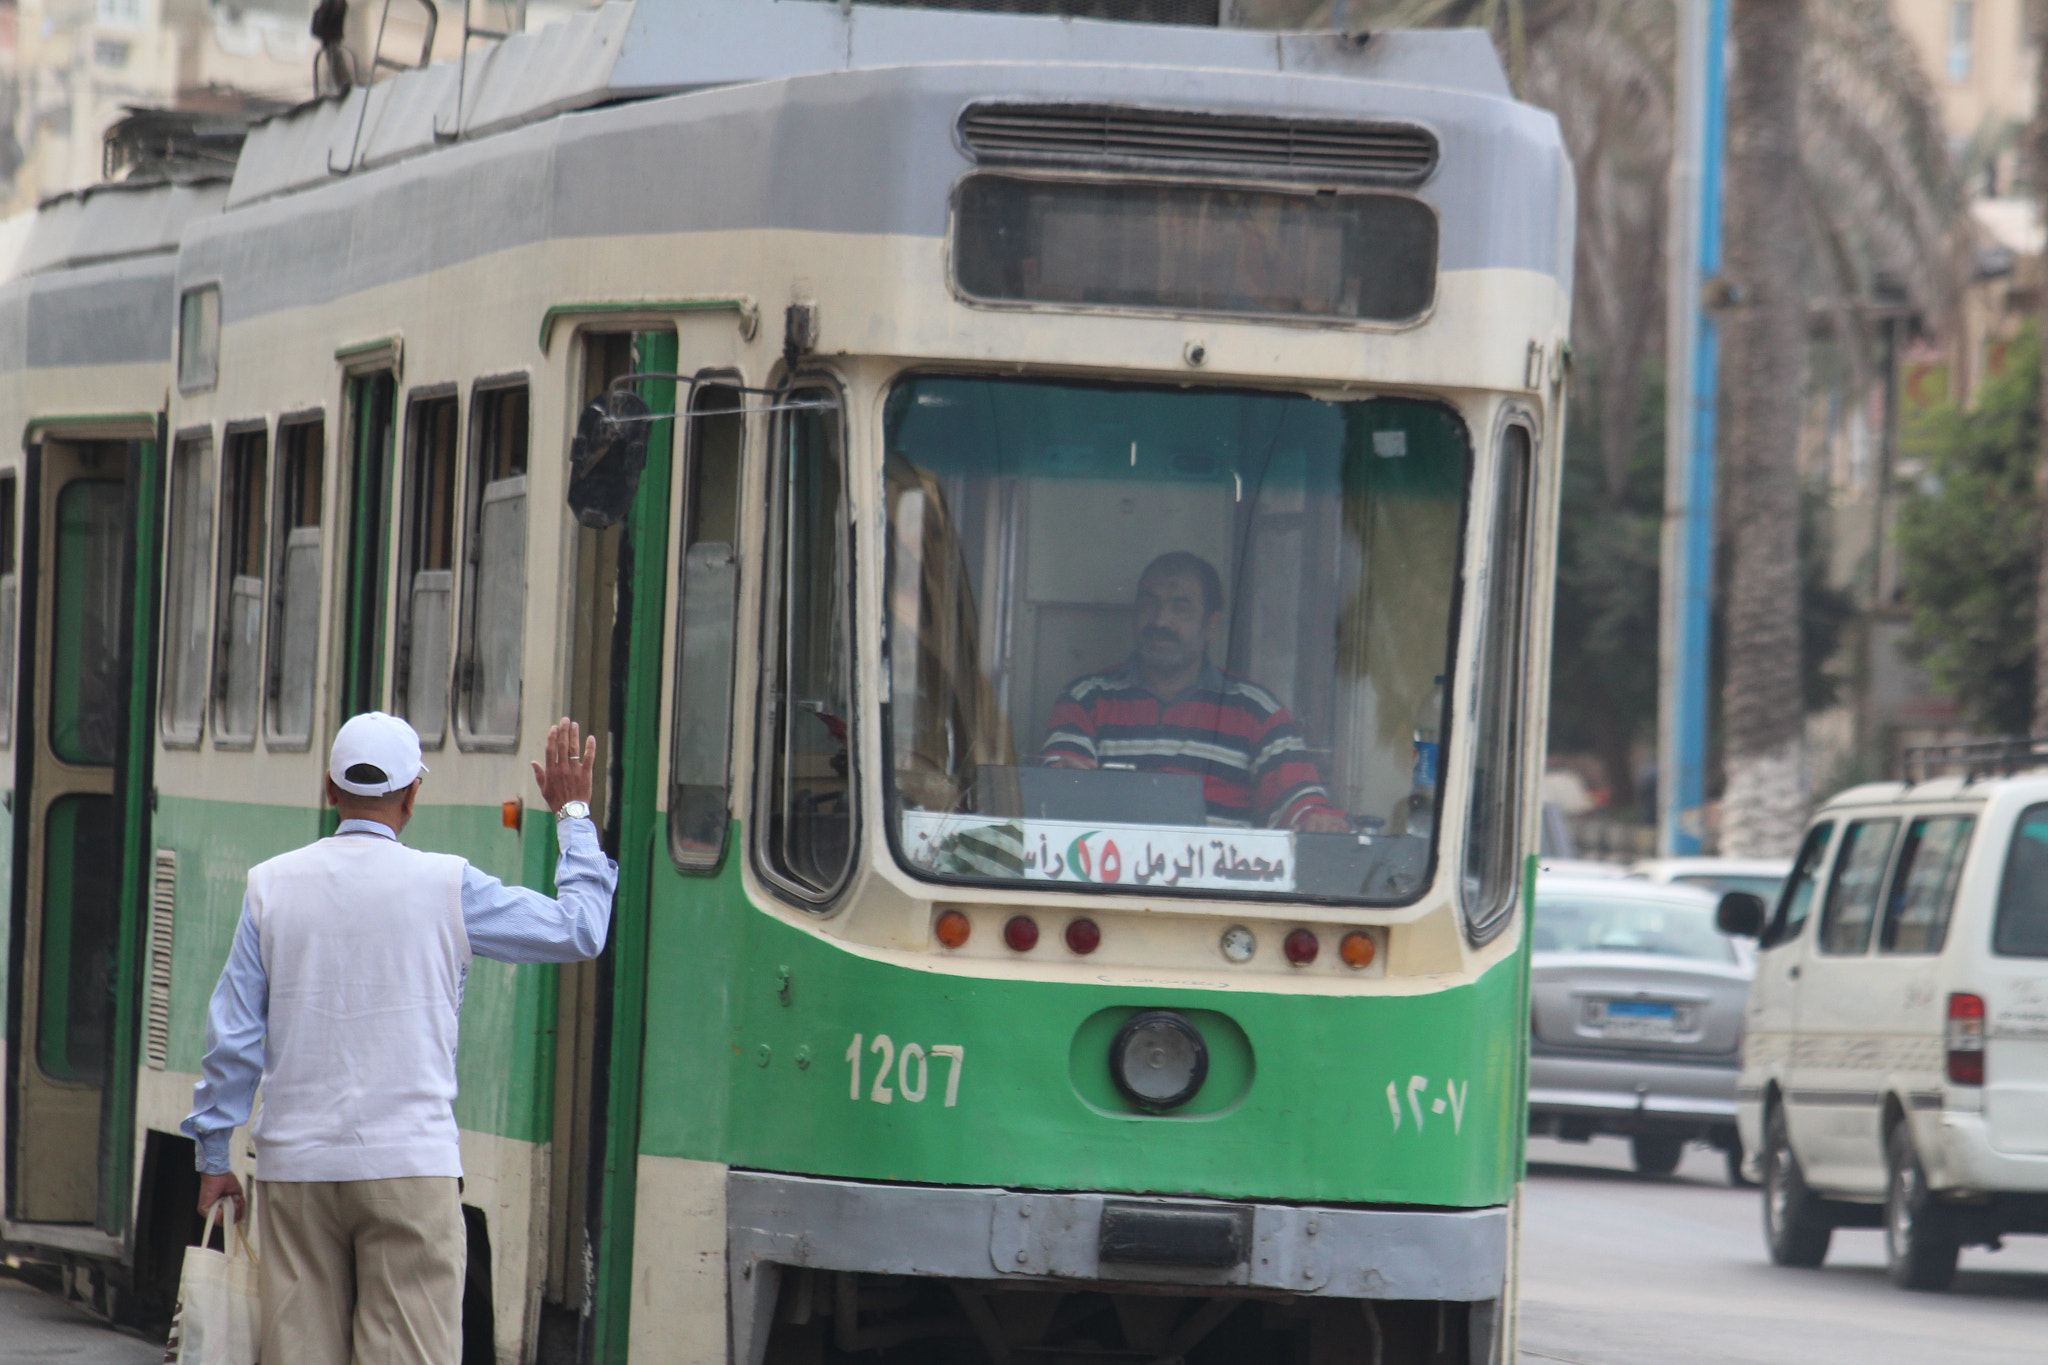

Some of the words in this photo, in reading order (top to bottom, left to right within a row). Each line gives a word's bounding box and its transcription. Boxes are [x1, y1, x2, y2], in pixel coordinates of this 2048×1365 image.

[1134, 840, 1205, 887] الرمل
[1210, 840, 1286, 883] محطة
[845, 1033, 964, 1108] 1207
[1386, 1075, 1468, 1136] ١٢٠٧
